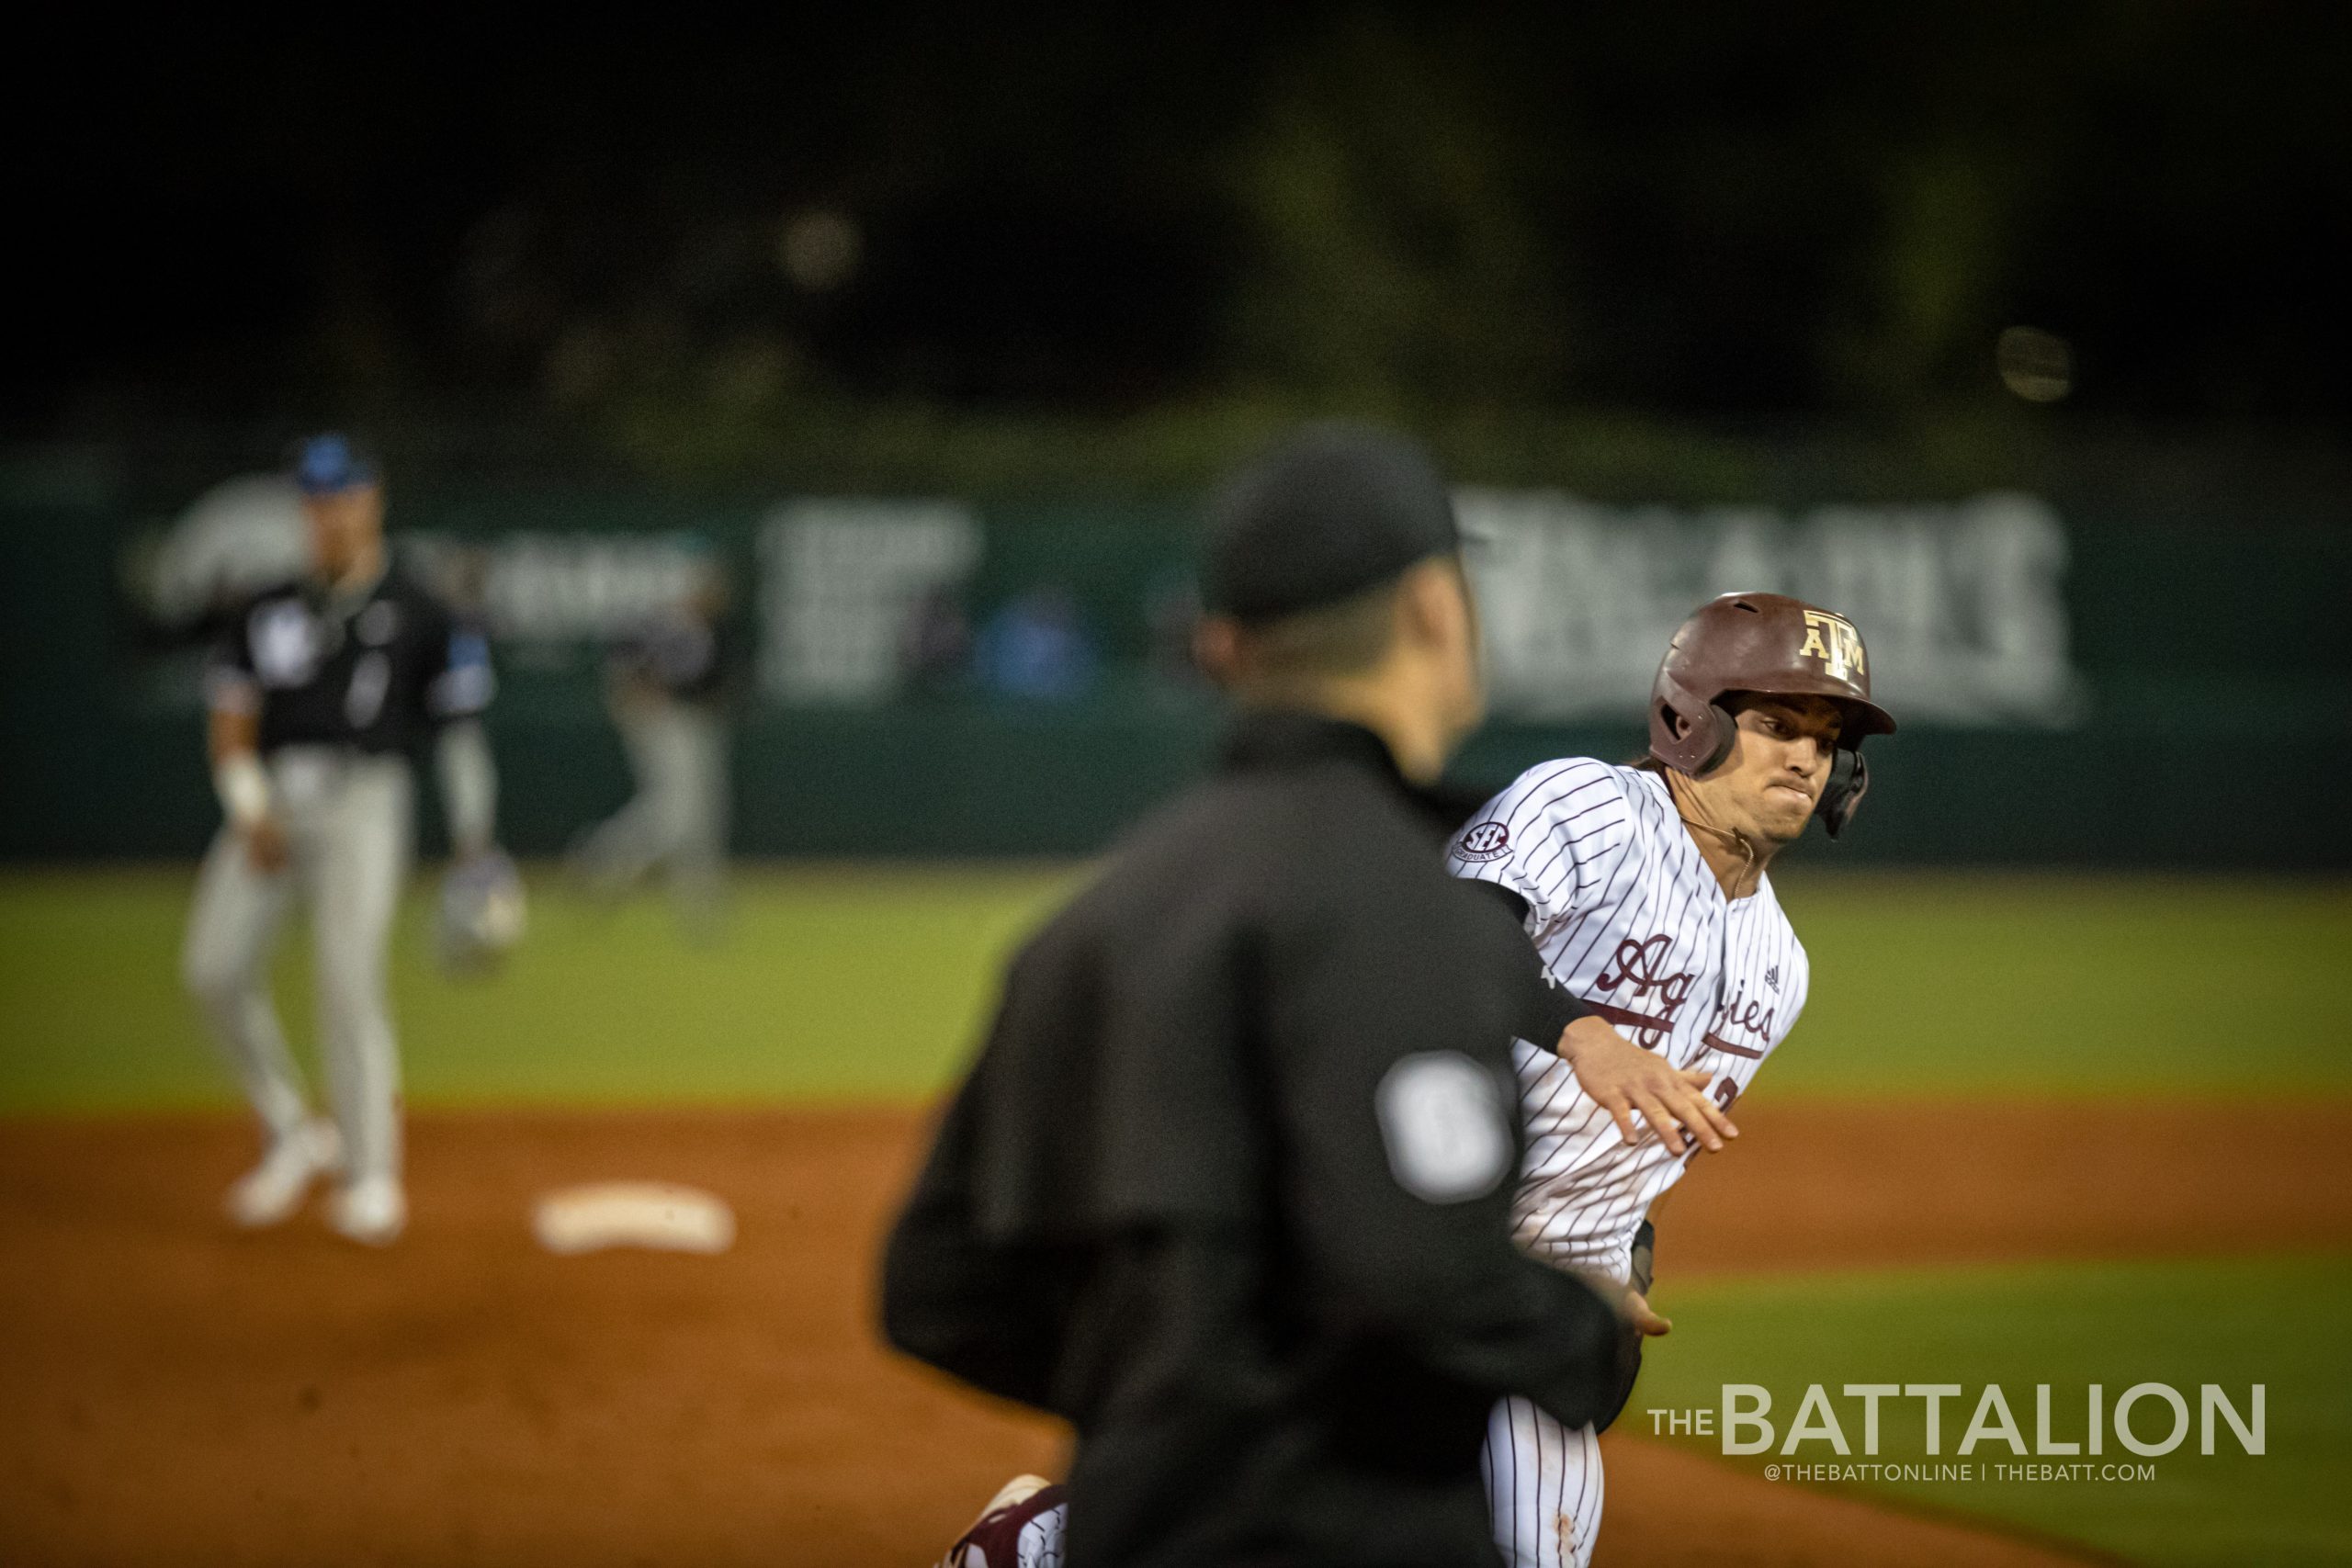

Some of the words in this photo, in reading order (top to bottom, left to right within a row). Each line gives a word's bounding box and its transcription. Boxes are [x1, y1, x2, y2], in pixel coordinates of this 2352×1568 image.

[1465, 824, 1507, 852] SEC
[1453, 844, 1500, 862] GRADUATE
[1596, 933, 1775, 1051] Agies
